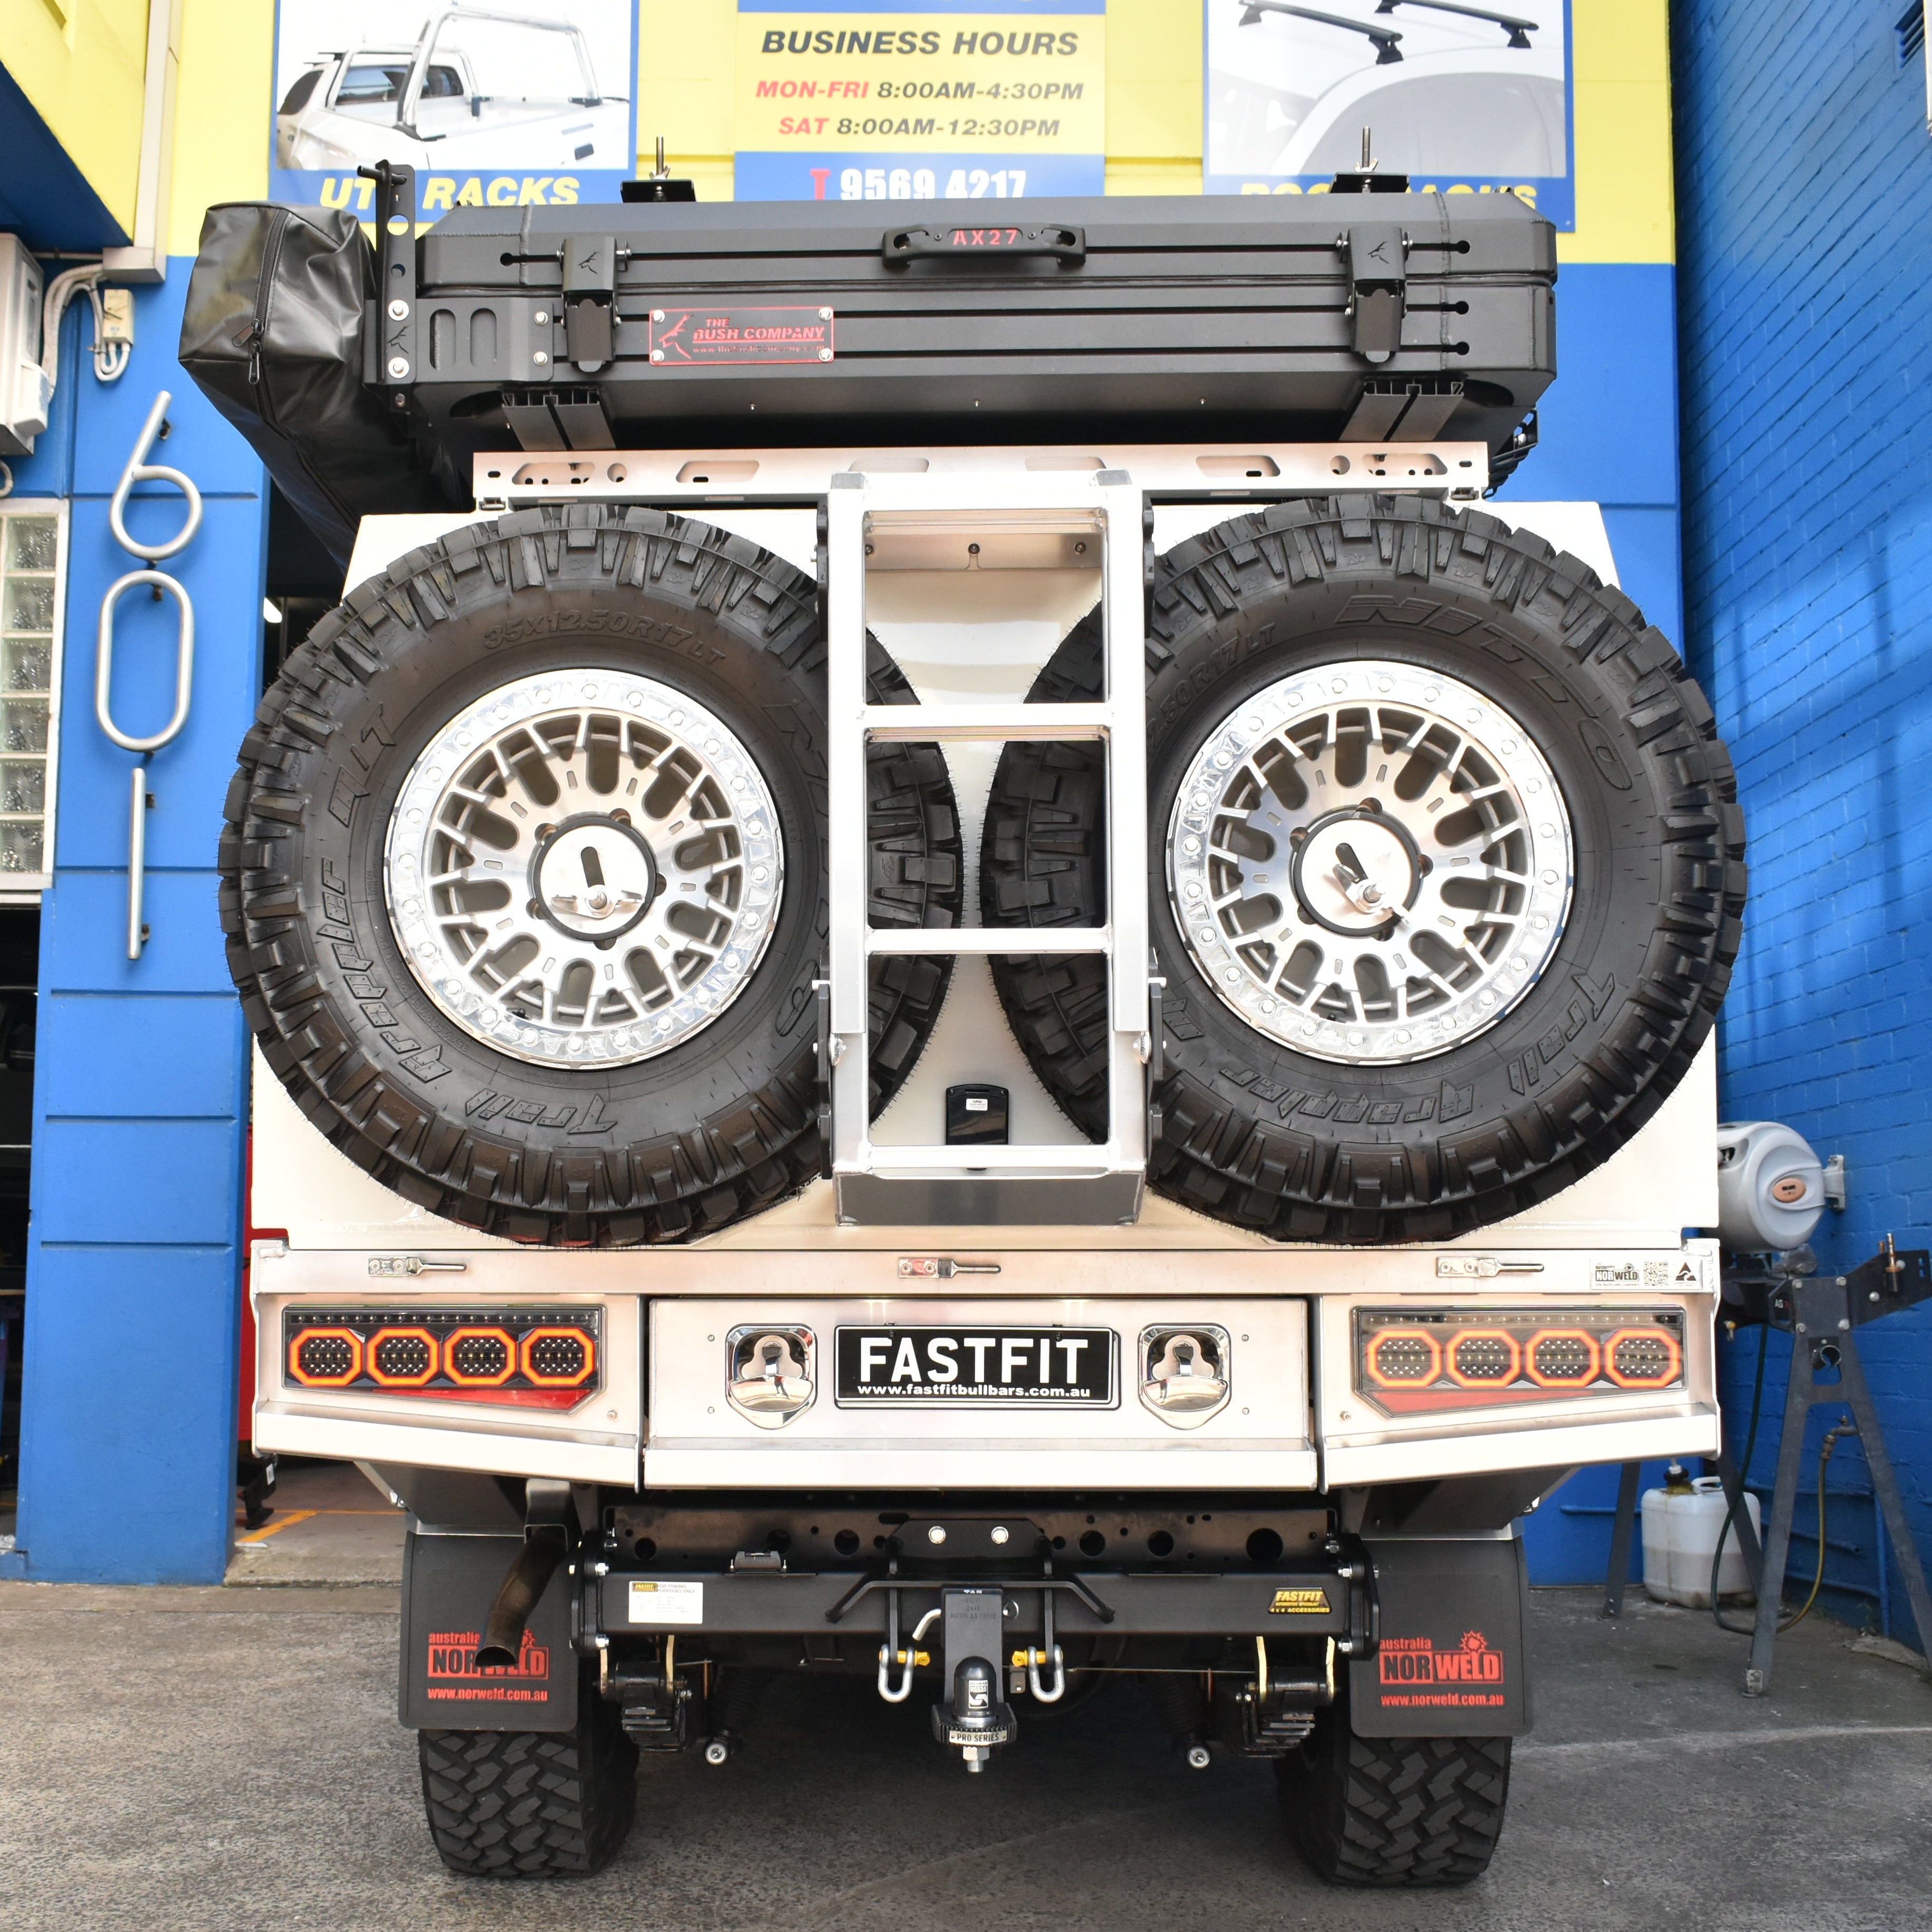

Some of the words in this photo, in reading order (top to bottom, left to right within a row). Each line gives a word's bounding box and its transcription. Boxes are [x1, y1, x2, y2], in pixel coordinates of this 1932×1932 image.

[761, 30, 941, 54] BUSINESS
[952, 32, 1079, 55] HOURS
[756, 81, 869, 98] MON-FRI
[878, 82, 1083, 100] 8:00AM-4:30PM
[778, 117, 830, 135] SAT
[836, 119, 1060, 136] 8:00AM-12:30PM
[810, 169, 830, 200] T
[840, 169, 935, 200] 9569
[945, 170, 1026, 199] 4217
[320, 178, 376, 209] UT
[422, 177, 580, 210] RACKS
[953, 229, 1018, 245] AX27
[706, 318, 730, 327] THE
[693, 328, 738, 340] BUSH
[744, 327, 825, 339] COMPANY
[1595, 1270, 1638, 1281] NORWELD
[861, 1337, 1088, 1384] FASTFIT
[857, 1384, 1090, 1397] www.fastfitbullbars.com.au
[1275, 1591, 1323, 1601] FASTFIT
[429, 1632, 480, 1644] australia
[1379, 1637, 1432, 1650] australia
[1384, 1652, 1500, 1681] NORWELD
[428, 1688, 548, 1701] www.norweld.com.au
[1381, 1693, 1505, 1706] www.norweld.com.au
[974, 1733, 999, 1742] SERIES
